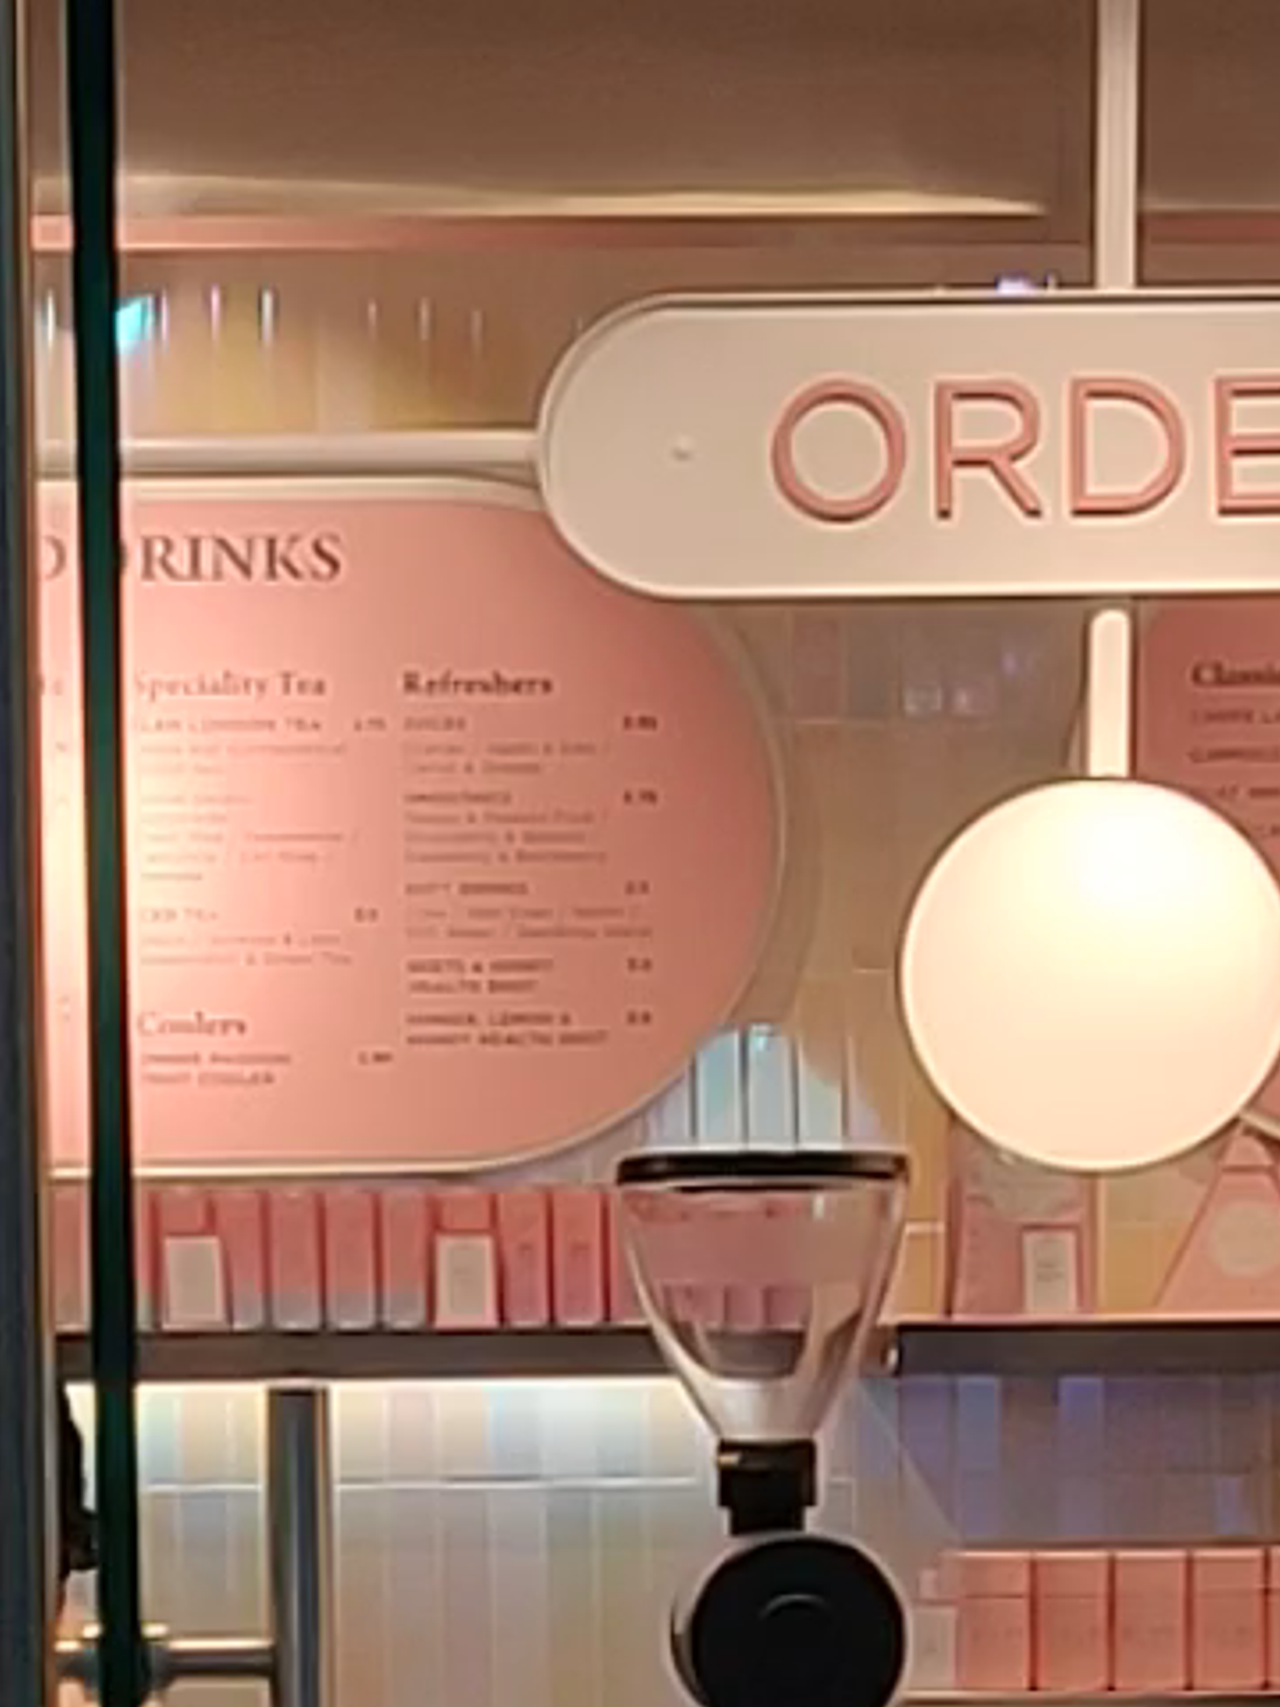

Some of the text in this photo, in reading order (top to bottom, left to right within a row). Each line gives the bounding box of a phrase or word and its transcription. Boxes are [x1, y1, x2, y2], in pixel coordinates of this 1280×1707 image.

[119, 533, 341, 582] RINKS
[281, 670, 327, 695] Tea
[403, 669, 553, 696] Refreshers
[137, 1010, 247, 1035] Coolers
